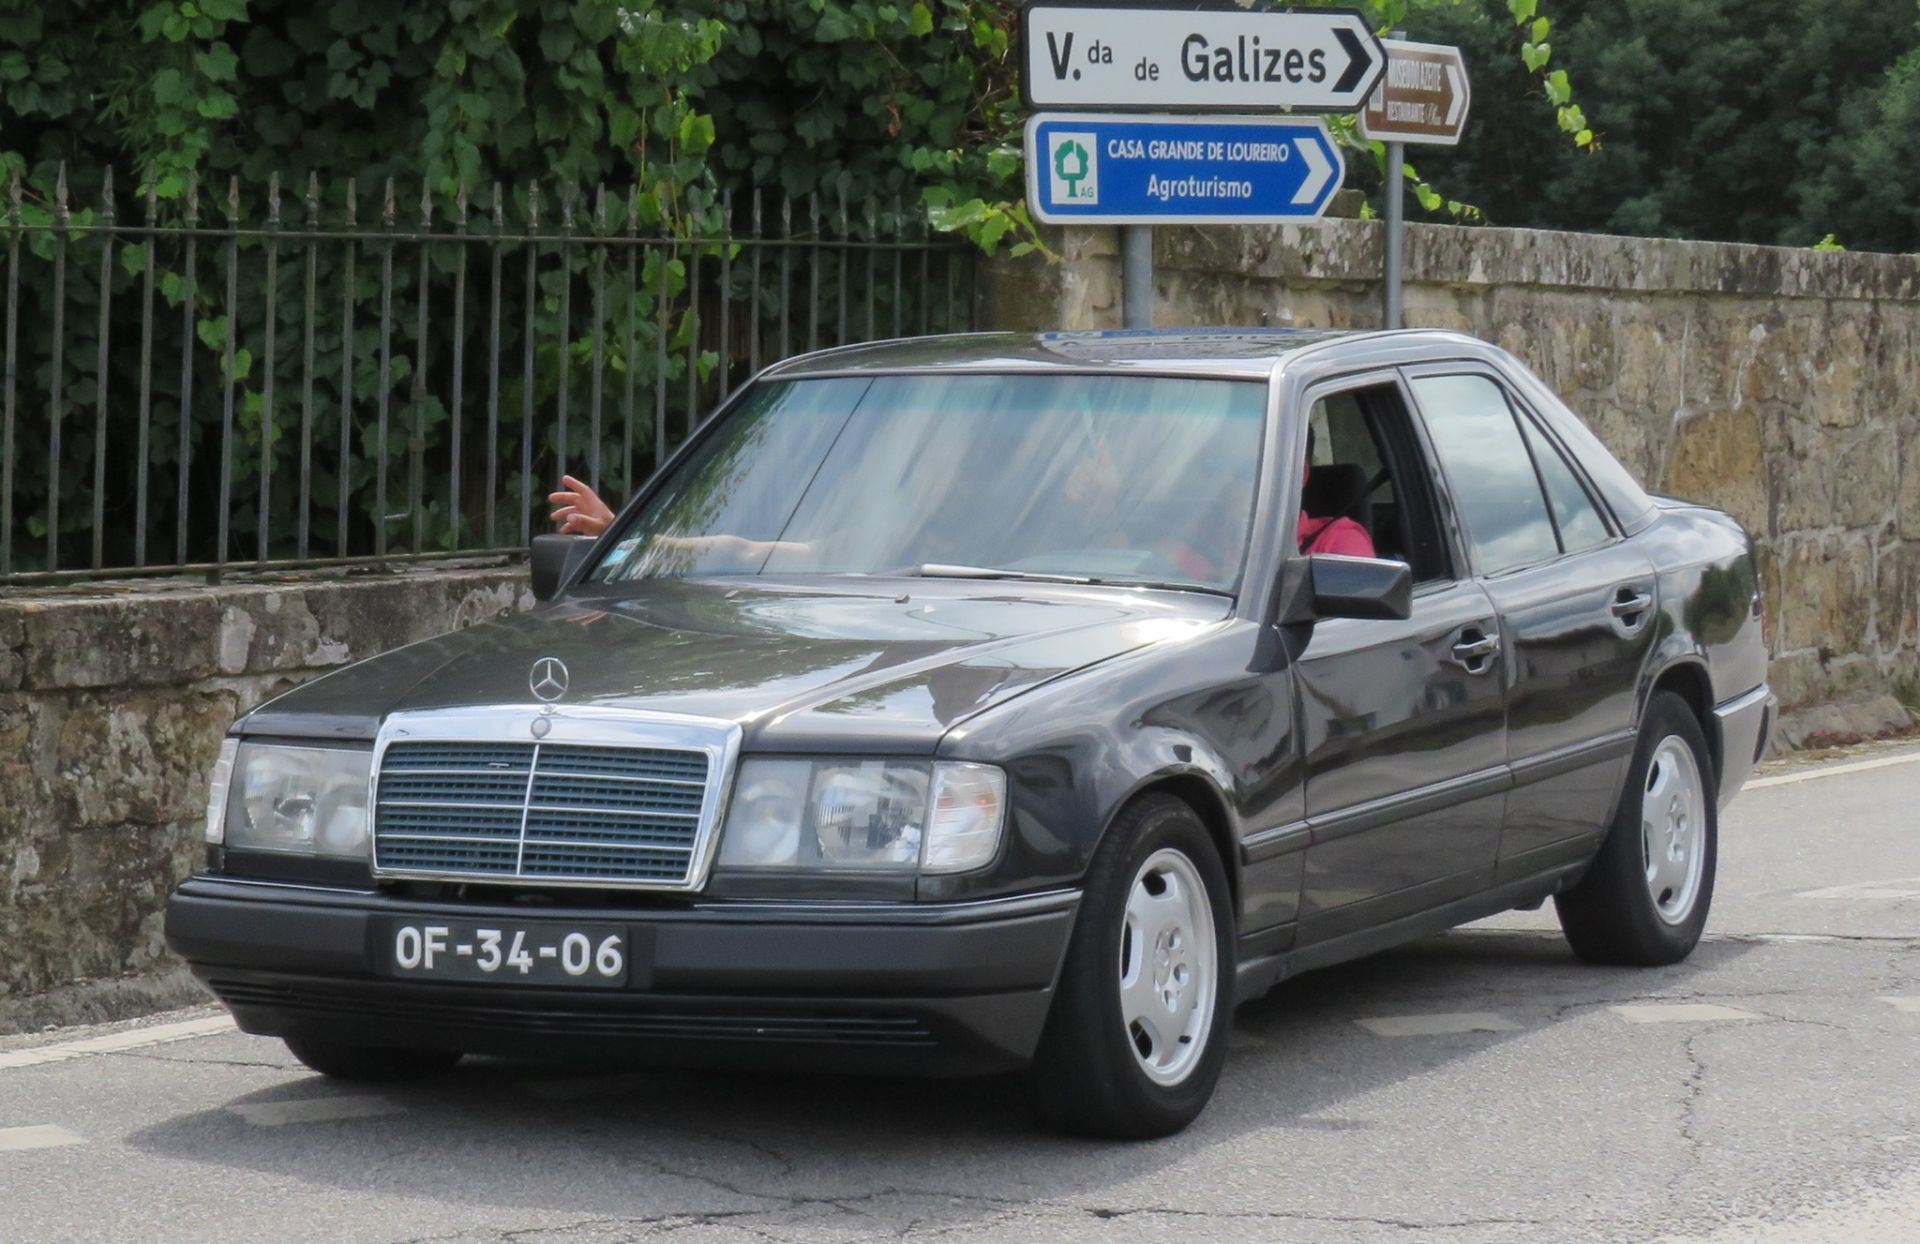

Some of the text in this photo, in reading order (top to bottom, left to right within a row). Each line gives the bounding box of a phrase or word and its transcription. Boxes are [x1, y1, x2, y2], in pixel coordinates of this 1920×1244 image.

[1134, 56, 1160, 81] de
[1180, 32, 1327, 84] Galizes
[1108, 139, 1289, 163] CASA GRANDE DE LOUREIRO
[1080, 187, 1094, 198] AG
[1147, 174, 1252, 201] Agroturismo
[395, 925, 624, 977] OF-34-06
